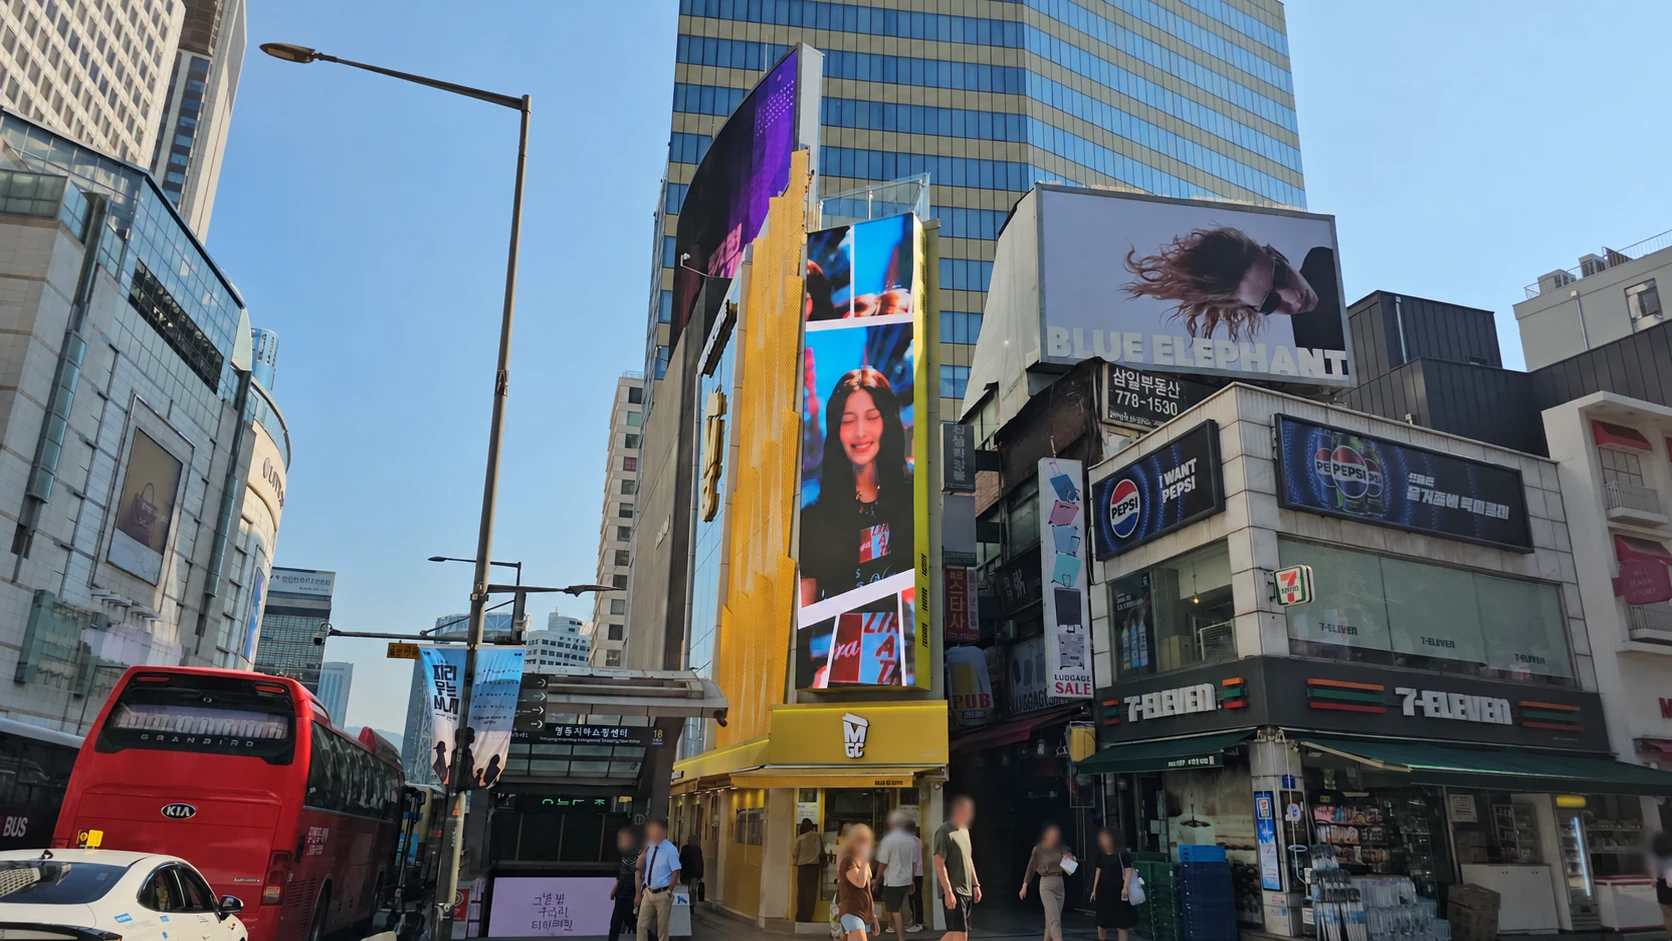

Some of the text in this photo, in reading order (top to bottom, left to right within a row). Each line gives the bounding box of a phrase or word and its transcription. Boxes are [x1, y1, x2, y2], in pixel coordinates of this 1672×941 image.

[1047, 326, 1349, 379] BLUE ELEPHANT
[1113, 368, 1180, 399] 삼일부동산
[1115, 390, 1177, 416] 778-1530
[1159, 458, 1197, 488] I WANT
[1333, 464, 1367, 481] PEPSI
[1162, 475, 1196, 503] PEPSI
[1112, 496, 1138, 519] PEPSI
[1054, 673, 1091, 683] LUGGAGE
[1055, 682, 1091, 695] SALE
[952, 693, 991, 709] PUB
[141, 734, 253, 748] GRANBIRD
[166, 806, 190, 817] KIA
[3, 817, 27, 837] BUS
